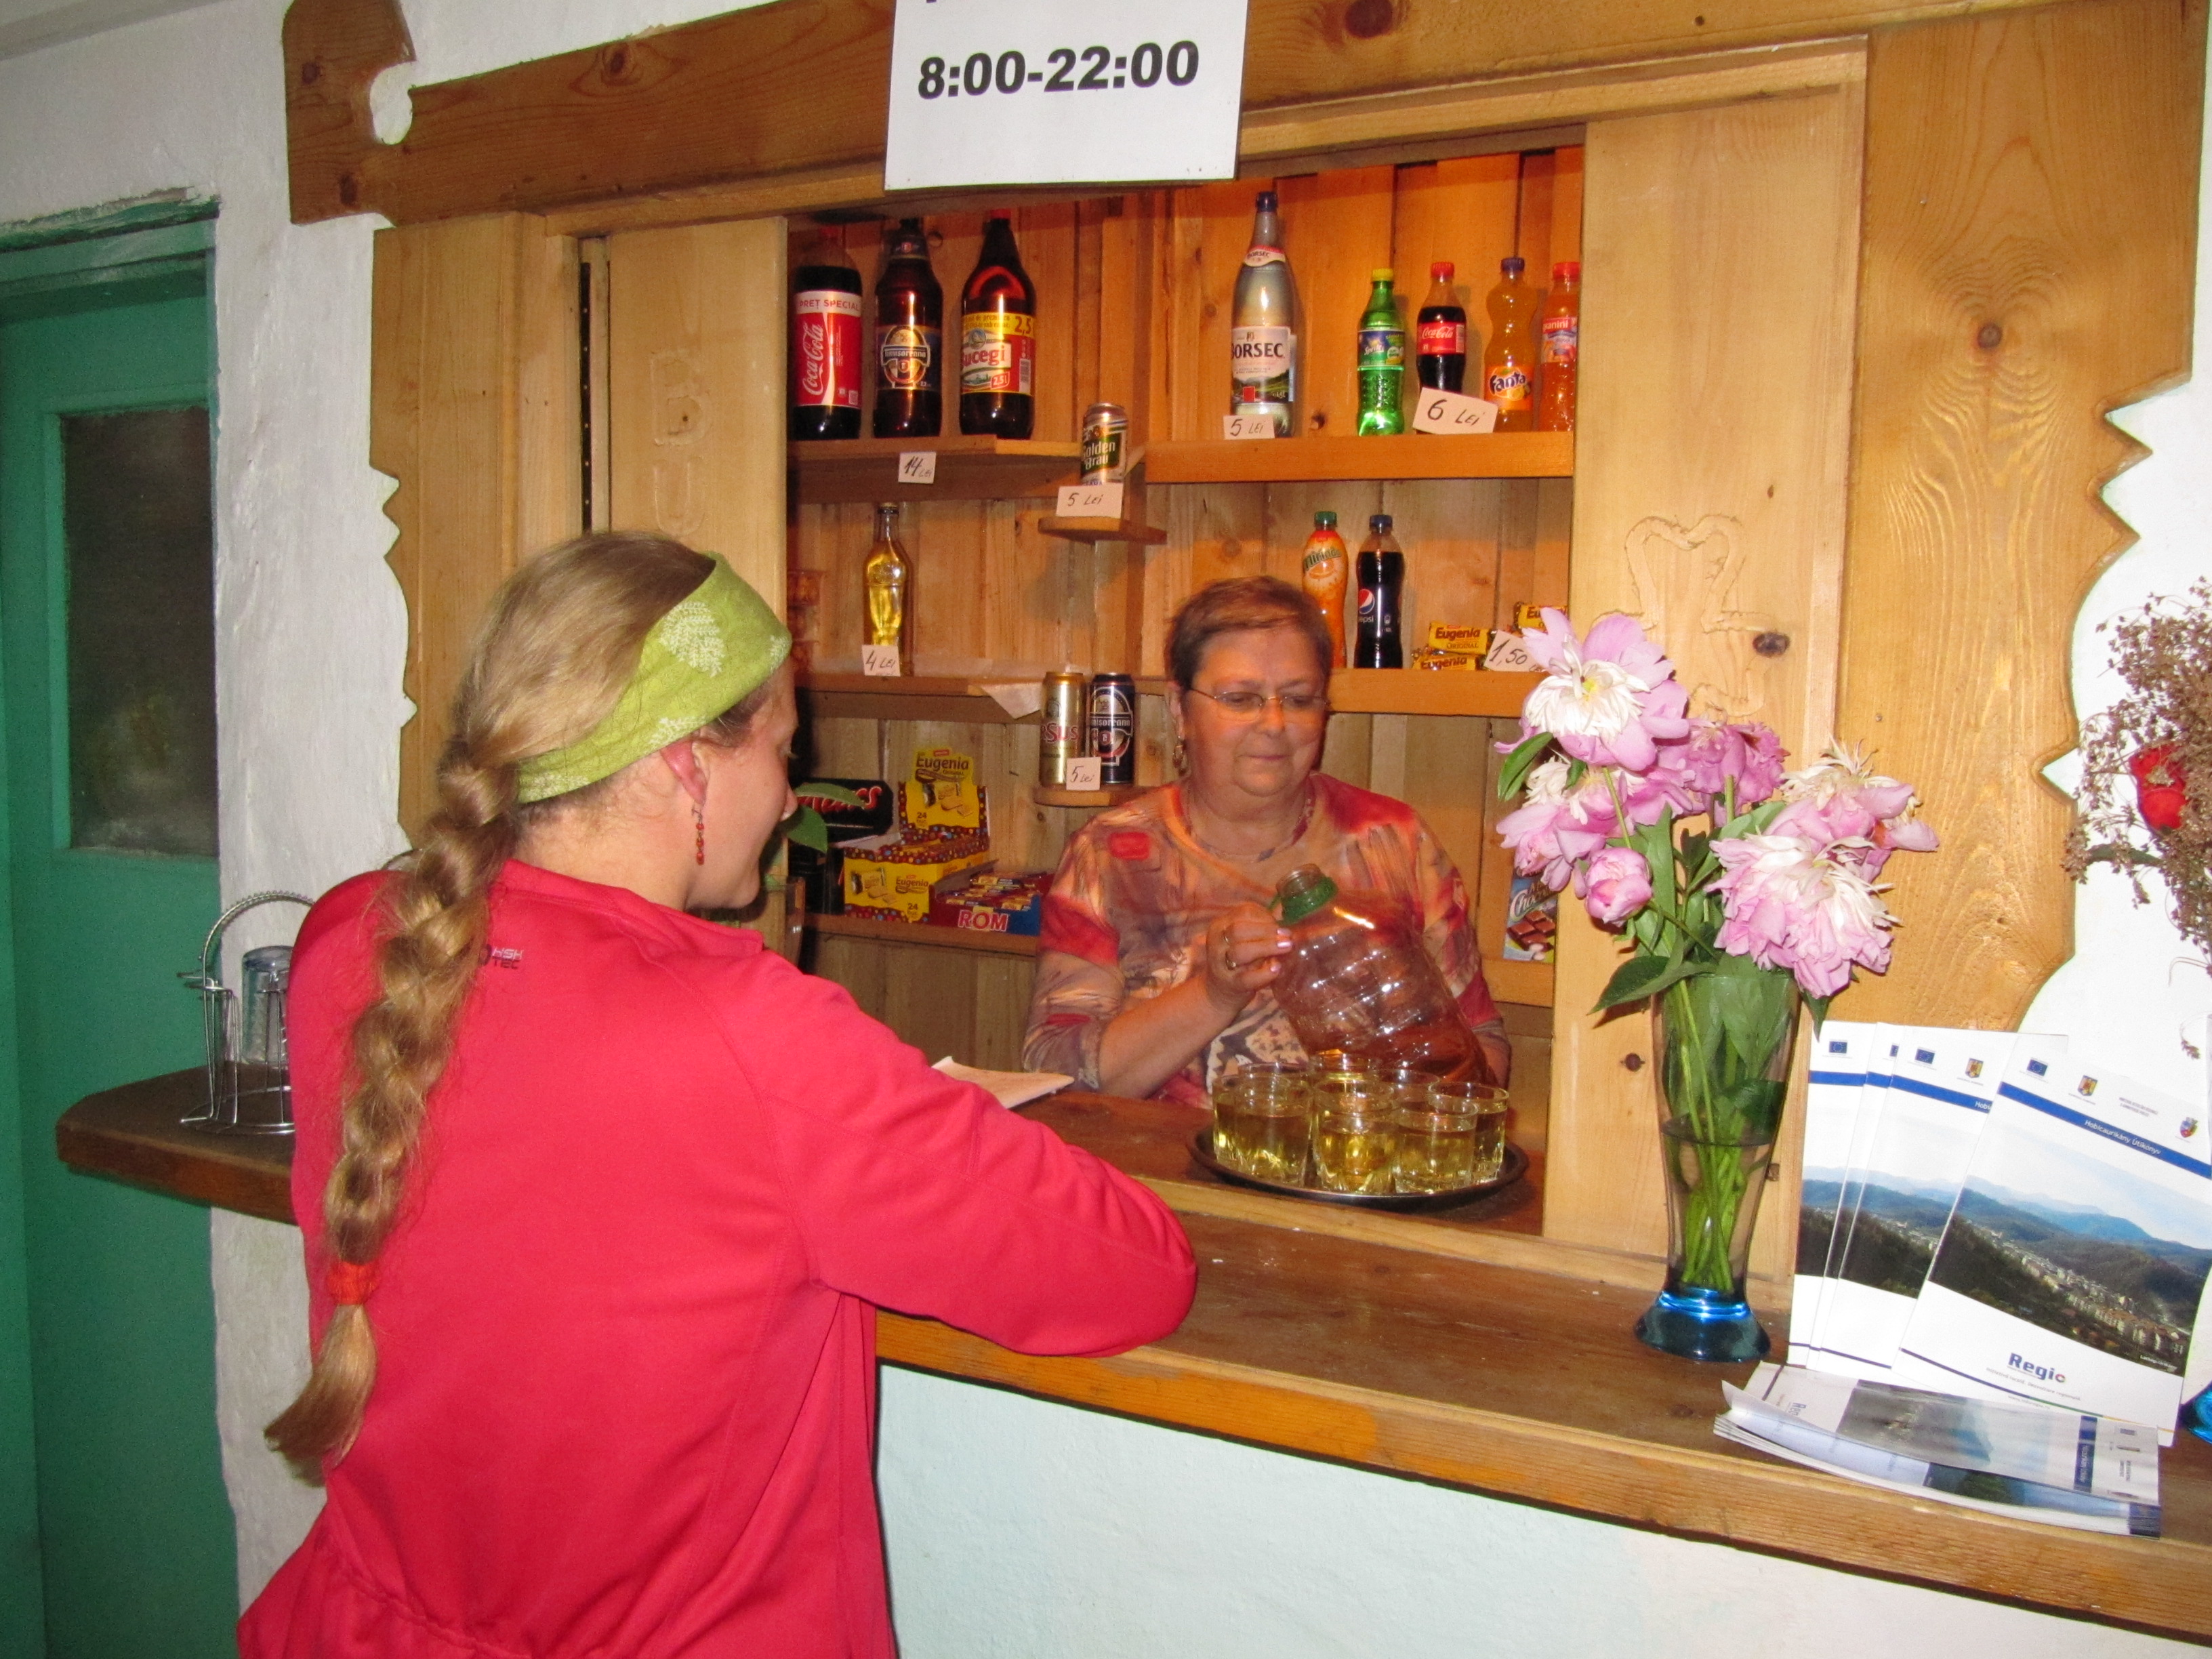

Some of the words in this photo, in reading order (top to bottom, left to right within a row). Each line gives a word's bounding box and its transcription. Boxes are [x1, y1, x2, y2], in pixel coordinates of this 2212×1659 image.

[918, 40, 1200, 100] 8:00-22:00
[823, 300, 860, 312] SPECIAL
[961, 345, 1006, 367] ucegi
[1427, 398, 1447, 421] 6
[1230, 418, 1243, 437] 5
[1067, 493, 1080, 507] 5
[1435, 626, 1481, 641] Eugenia
[865, 650, 877, 671] 4
[1489, 639, 1528, 666] 1,50
[916, 751, 969, 772] Eugenia
[1071, 766, 1084, 783] 5
[958, 909, 1009, 933] ROM
[2008, 1352, 2066, 1383] Regio
